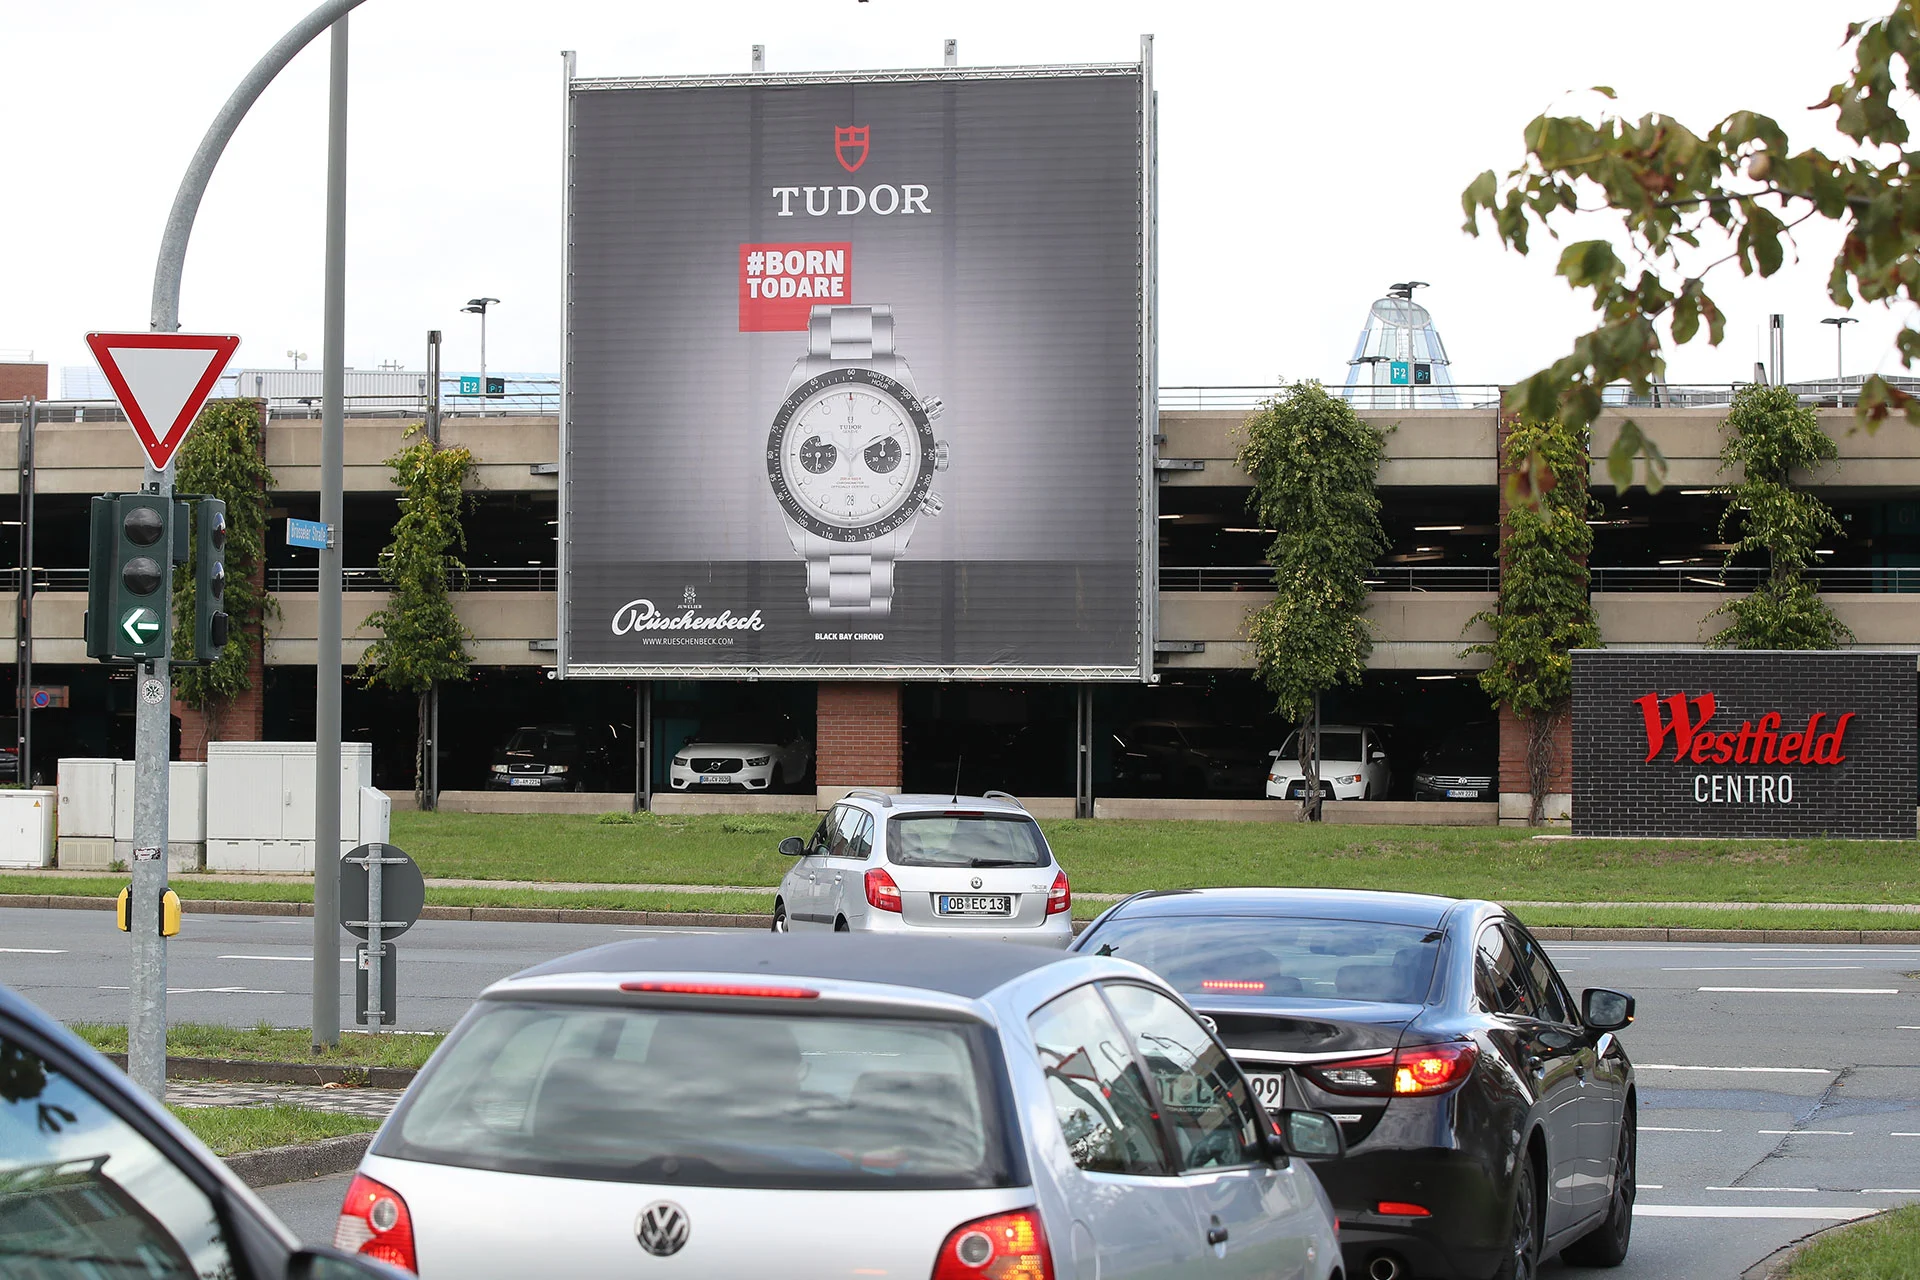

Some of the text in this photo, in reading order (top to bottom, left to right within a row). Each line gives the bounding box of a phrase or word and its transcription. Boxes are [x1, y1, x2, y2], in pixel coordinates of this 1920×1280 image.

[772, 184, 932, 216] TUDOR
[747, 250, 844, 275] #BORN
[747, 277, 844, 298] TODARE
[810, 378, 819, 386] 65
[867, 371, 896, 387] UNITS PER
[871, 379, 889, 390] HOUR
[463, 381, 477, 392] E2
[900, 389, 911, 400] 500
[785, 400, 793, 408] 70
[911, 400, 921, 412] 400
[772, 425, 779, 434] 75
[922, 423, 931, 435] 300
[767, 450, 774, 460] 80
[923, 473, 932, 486] 200
[777, 492, 784, 501] 90
[915, 490, 926, 502] 180
[902, 507, 914, 519] 160
[797, 517, 808, 527] 100
[892, 516, 904, 528] 150
[822, 530, 833, 539] 110
[863, 531, 876, 540] 130
[879, 525, 892, 535] 140
[611, 598, 765, 636] Rüschenbeck
[642, 637, 734, 646] WWW.RUESCHENBECK.COM
[1633, 692, 1856, 765] Westfield
[1694, 774, 1793, 803] CENTRO
[949, 897, 1004, 910] OB EC 13
